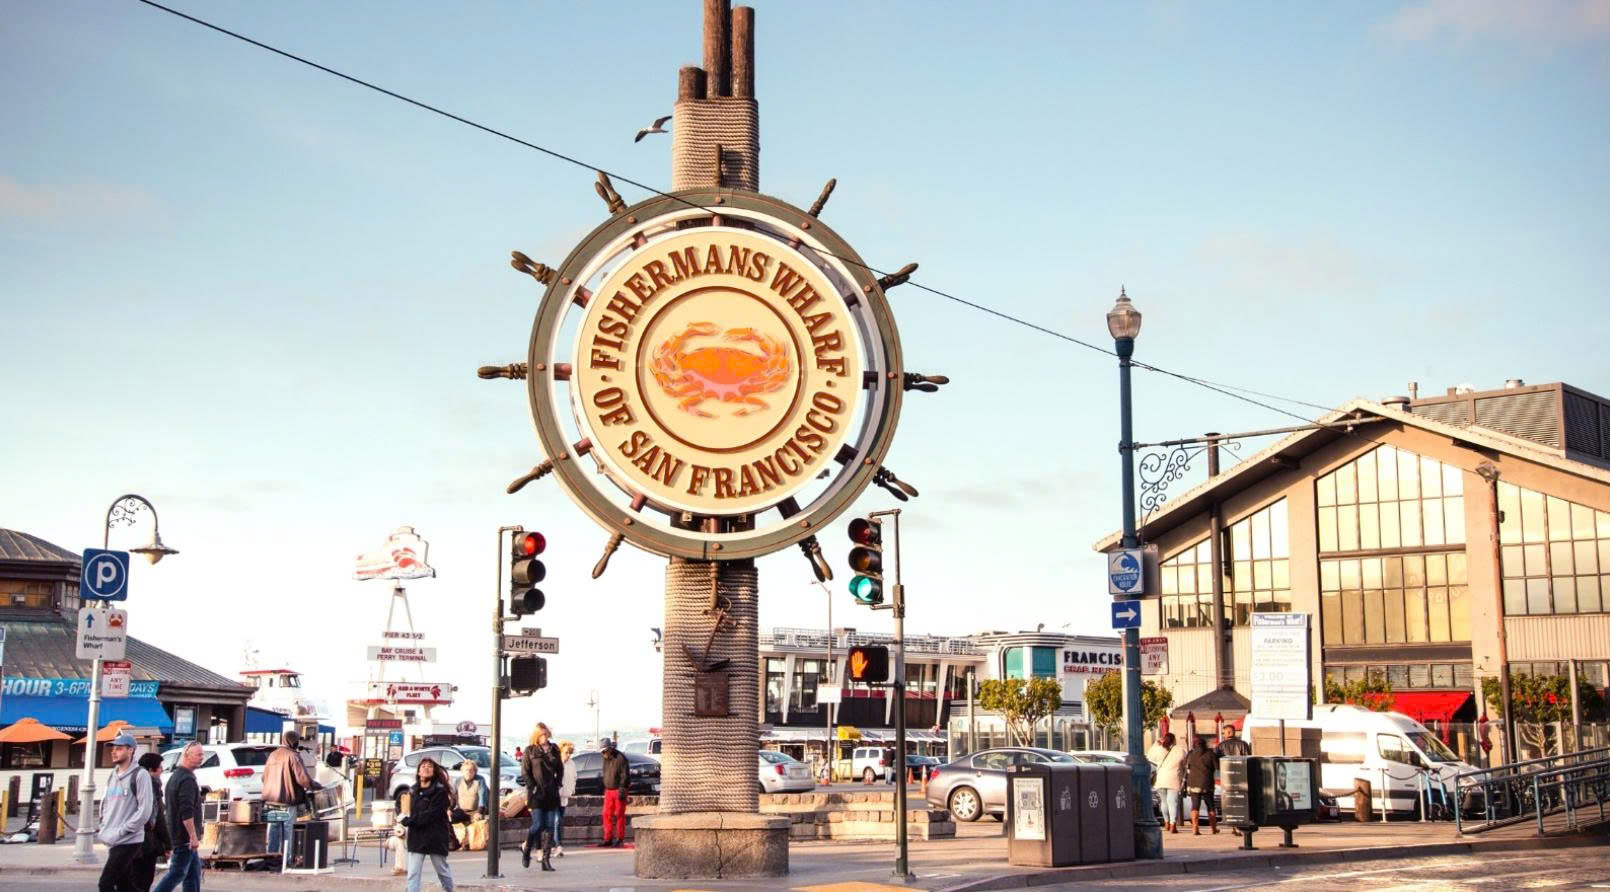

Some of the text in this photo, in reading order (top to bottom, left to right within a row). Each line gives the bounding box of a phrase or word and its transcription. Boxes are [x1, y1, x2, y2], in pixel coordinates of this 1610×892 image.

[590, 244, 848, 377] FISHERMANS WHARF
[593, 387, 842, 498] OF SAN FRANCISCO
[84, 634, 122, 643] Fisherman's
[509, 639, 555, 651] Jefferson
[2, 679, 52, 697] HOUR
